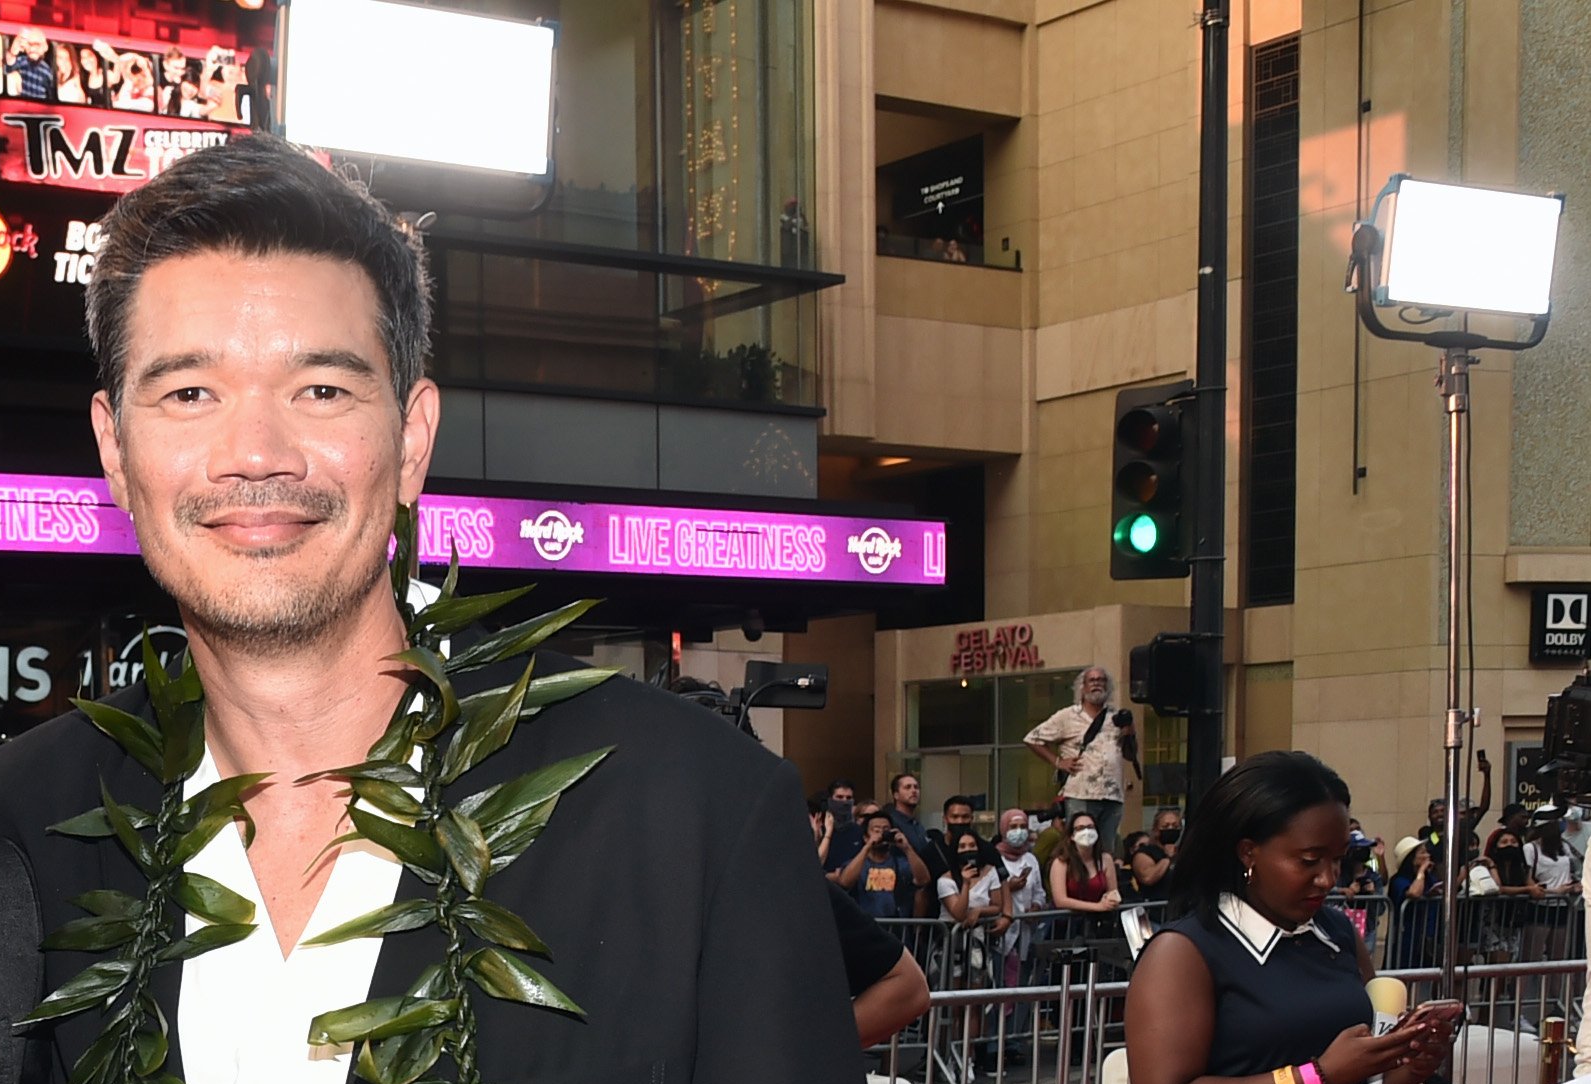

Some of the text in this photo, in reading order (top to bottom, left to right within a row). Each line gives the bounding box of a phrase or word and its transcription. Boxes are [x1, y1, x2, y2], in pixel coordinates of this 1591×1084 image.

[2, 114, 145, 180] TMZ
[144, 130, 229, 149] CELEBRITY
[608, 515, 827, 573] LIVE GREATNESS
[955, 623, 1033, 650] GELATO
[1545, 632, 1586, 646] DOLBY
[950, 645, 1045, 675] FESTIVAL
